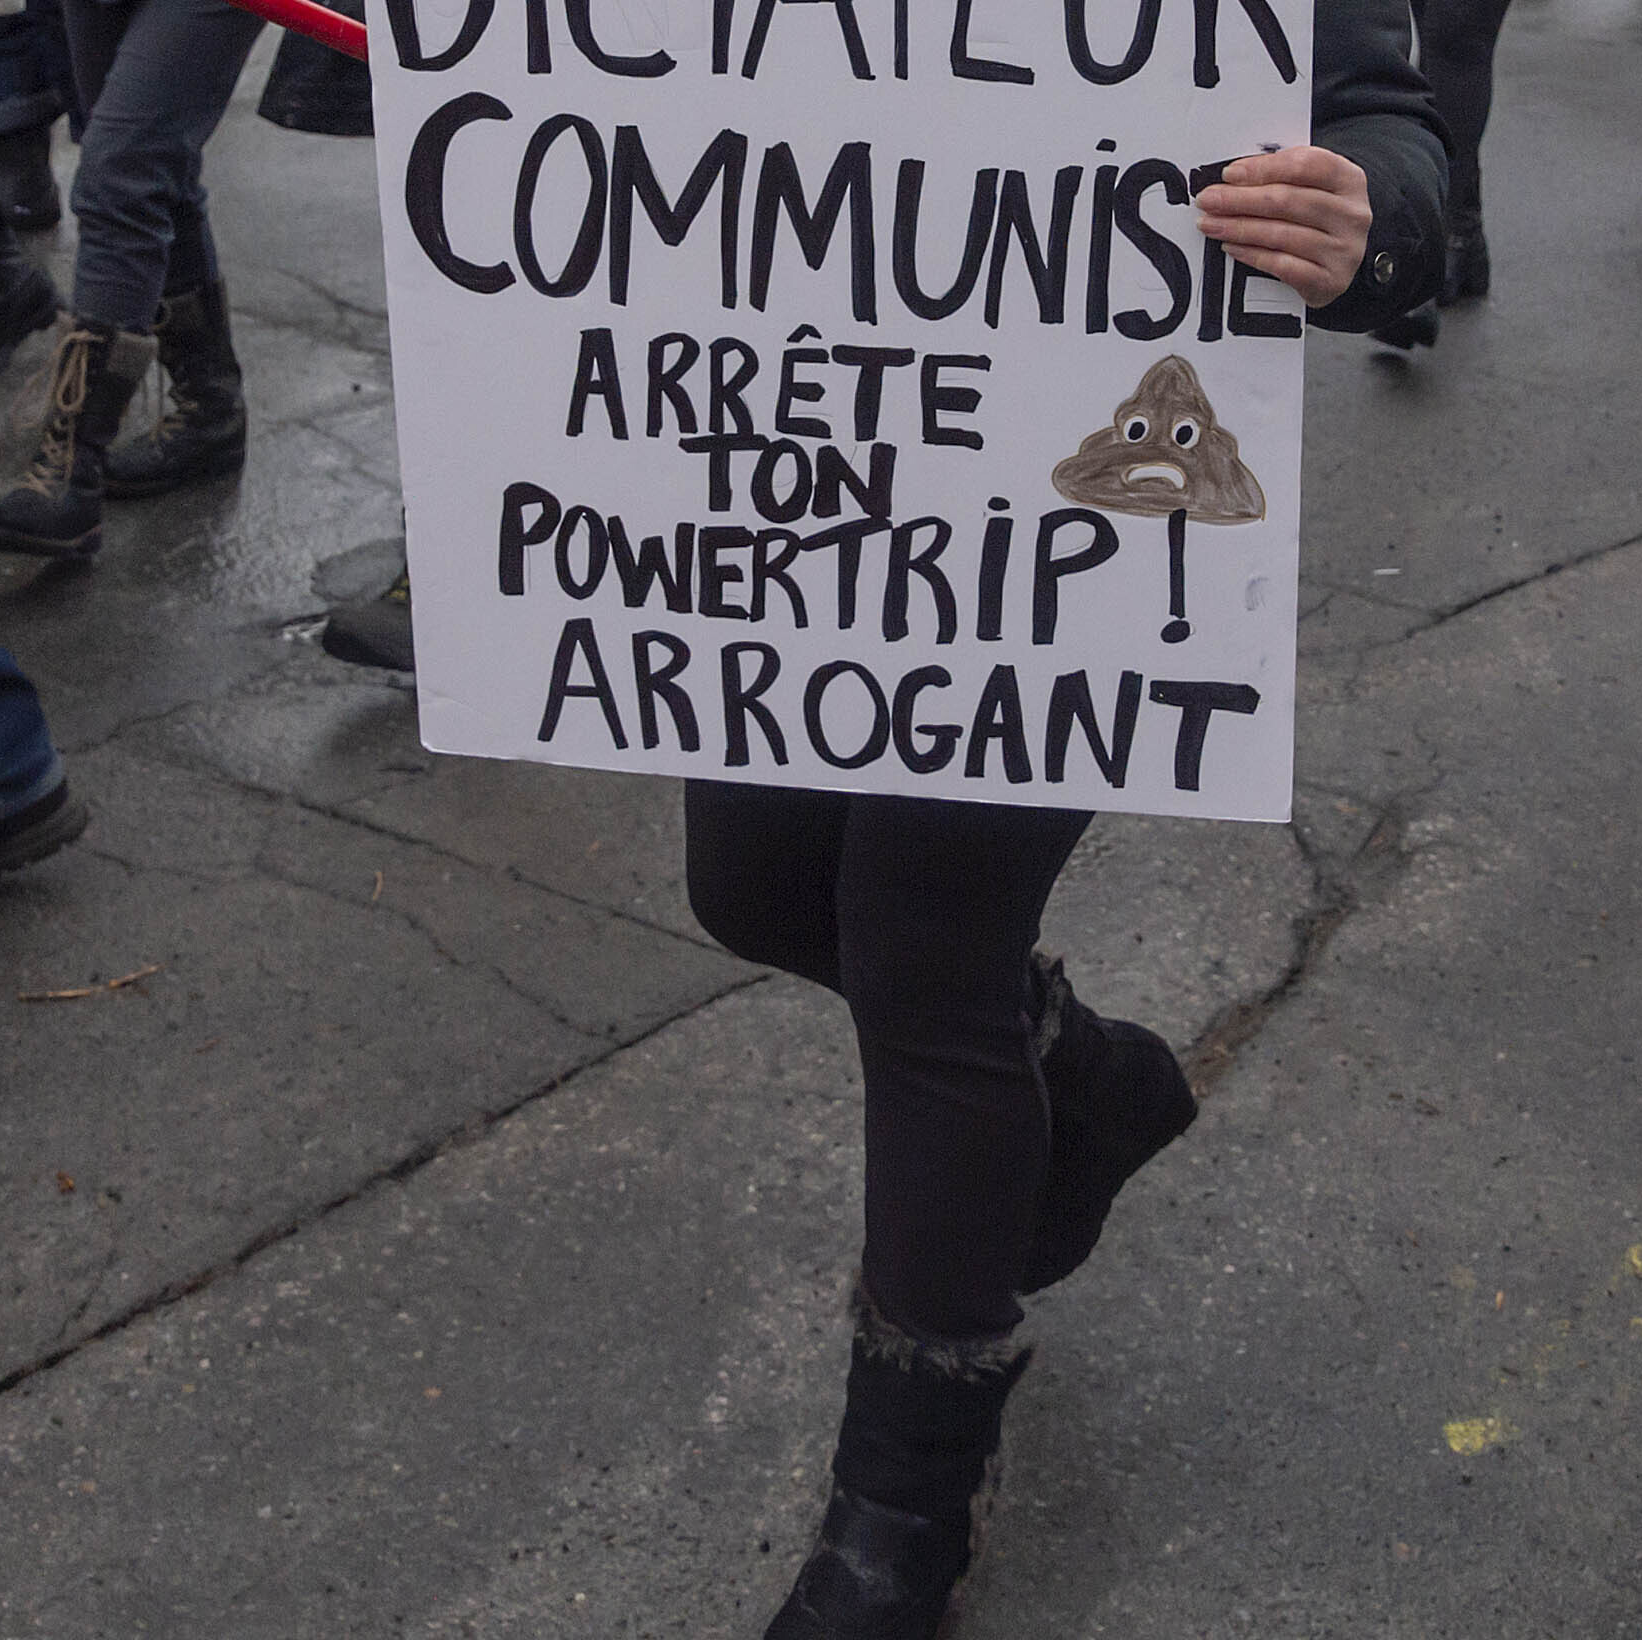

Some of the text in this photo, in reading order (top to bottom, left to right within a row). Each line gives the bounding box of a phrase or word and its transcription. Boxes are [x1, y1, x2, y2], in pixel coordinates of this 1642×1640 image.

[565, 323, 992, 451] ARRÊTE
[678, 432, 897, 524] TON
[537, 617, 1261, 792] ARROGANT
